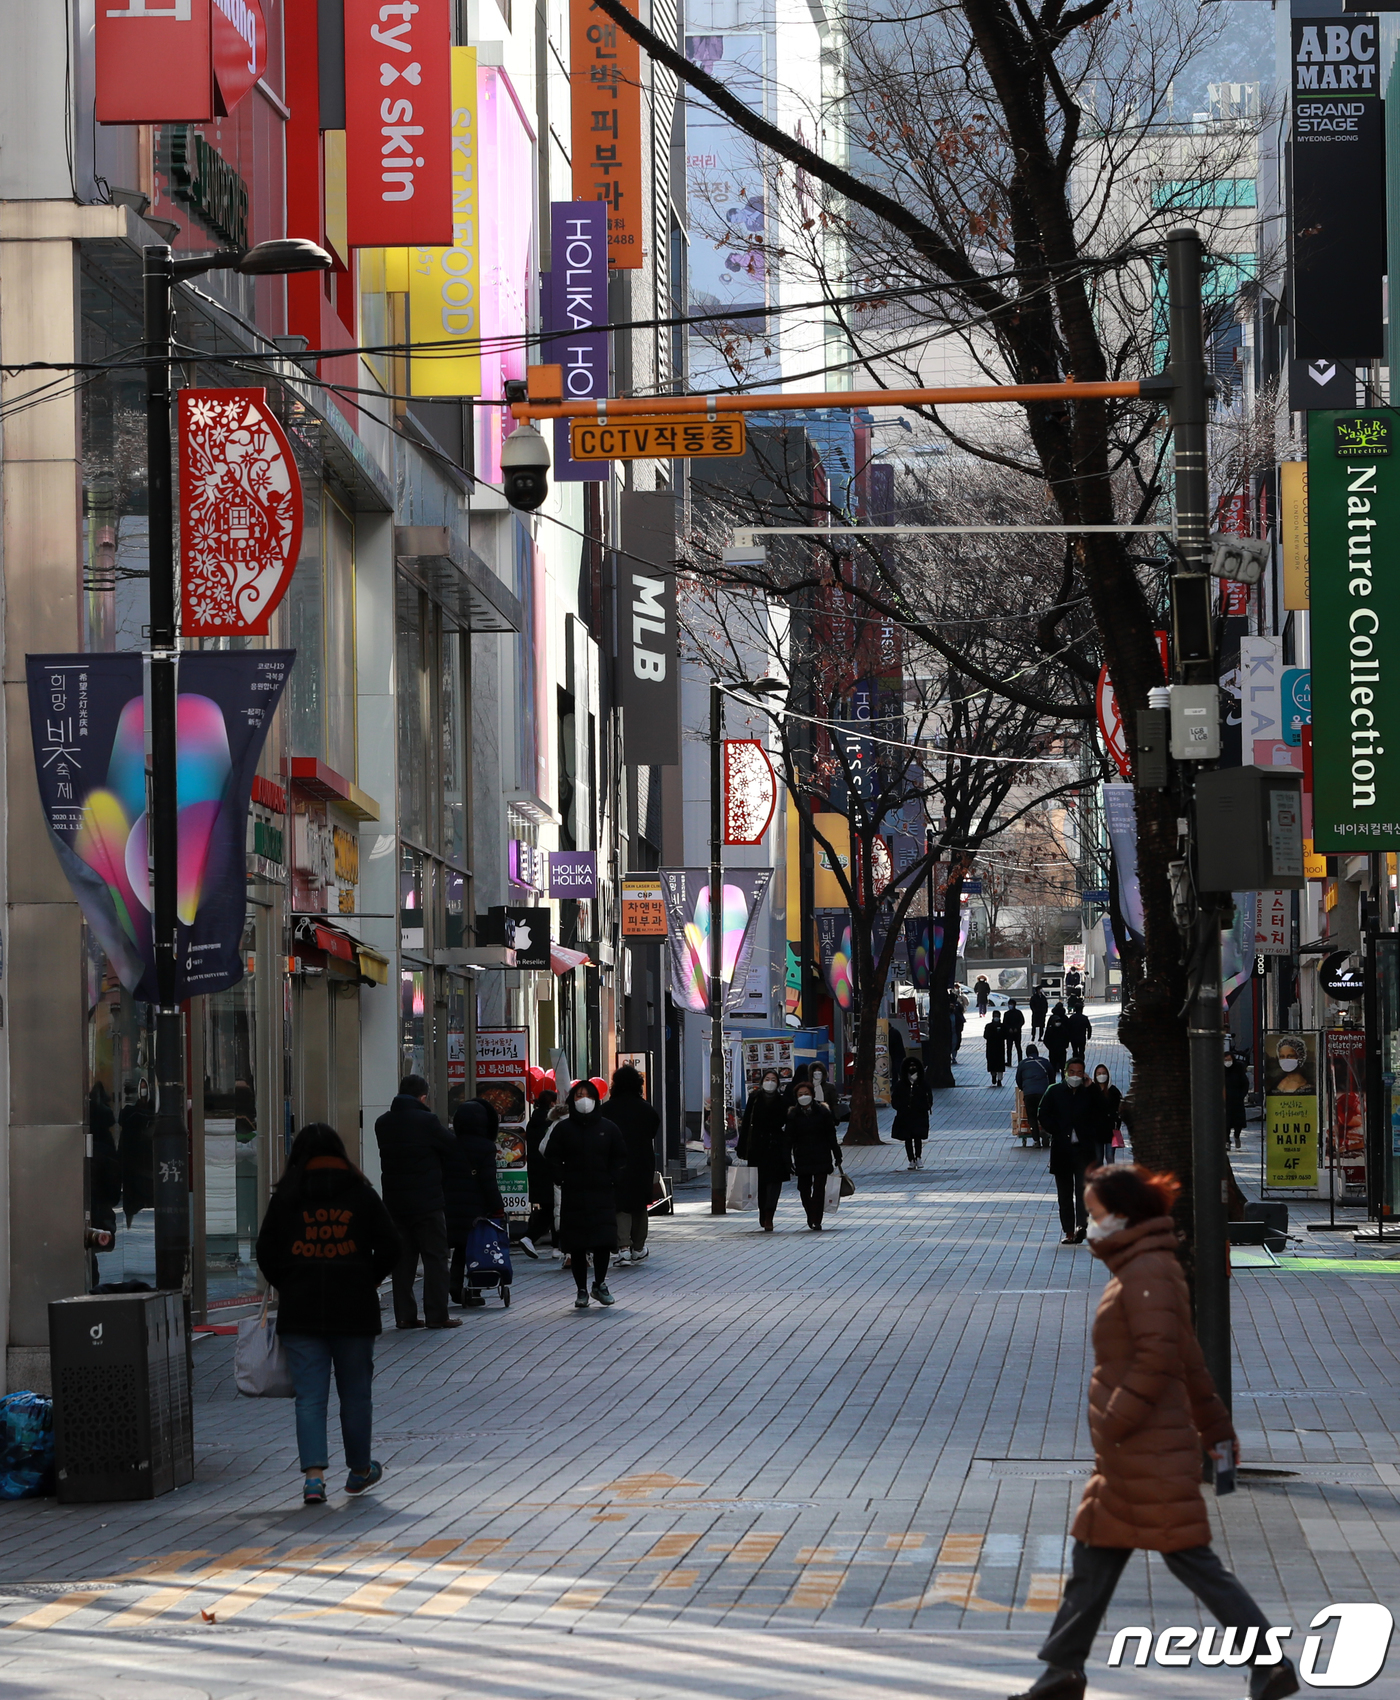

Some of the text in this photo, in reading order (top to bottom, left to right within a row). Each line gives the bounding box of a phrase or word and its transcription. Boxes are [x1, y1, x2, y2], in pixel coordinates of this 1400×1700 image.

[1297, 24, 1376, 62] ABC
[1297, 64, 1376, 89] MART
[1297, 103, 1365, 116] GRAND
[1297, 118, 1358, 131] STAGE
[380, 97, 424, 202] skin
[566, 219, 593, 334] HOLIKA
[632, 574, 666, 683] MLB
[1347, 465, 1385, 809] Nature Collection
[552, 865, 592, 874] HOLIKA
[552, 876, 592, 885] HOLIKA
[637, 891, 653, 899] CNP
[627, 902, 662, 914] 차앤박
[627, 916, 662, 927] 피부과
[522, 958, 546, 966] Reseller
[488, 1063, 523, 1075] 특선메뉴
[1273, 1123, 1311, 1134] JUNO
[1276, 1134, 1307, 1145] HAIR
[1284, 1158, 1300, 1170] 4F
[303, 1208, 353, 1224] LOVE
[305, 1225, 348, 1241] NOW
